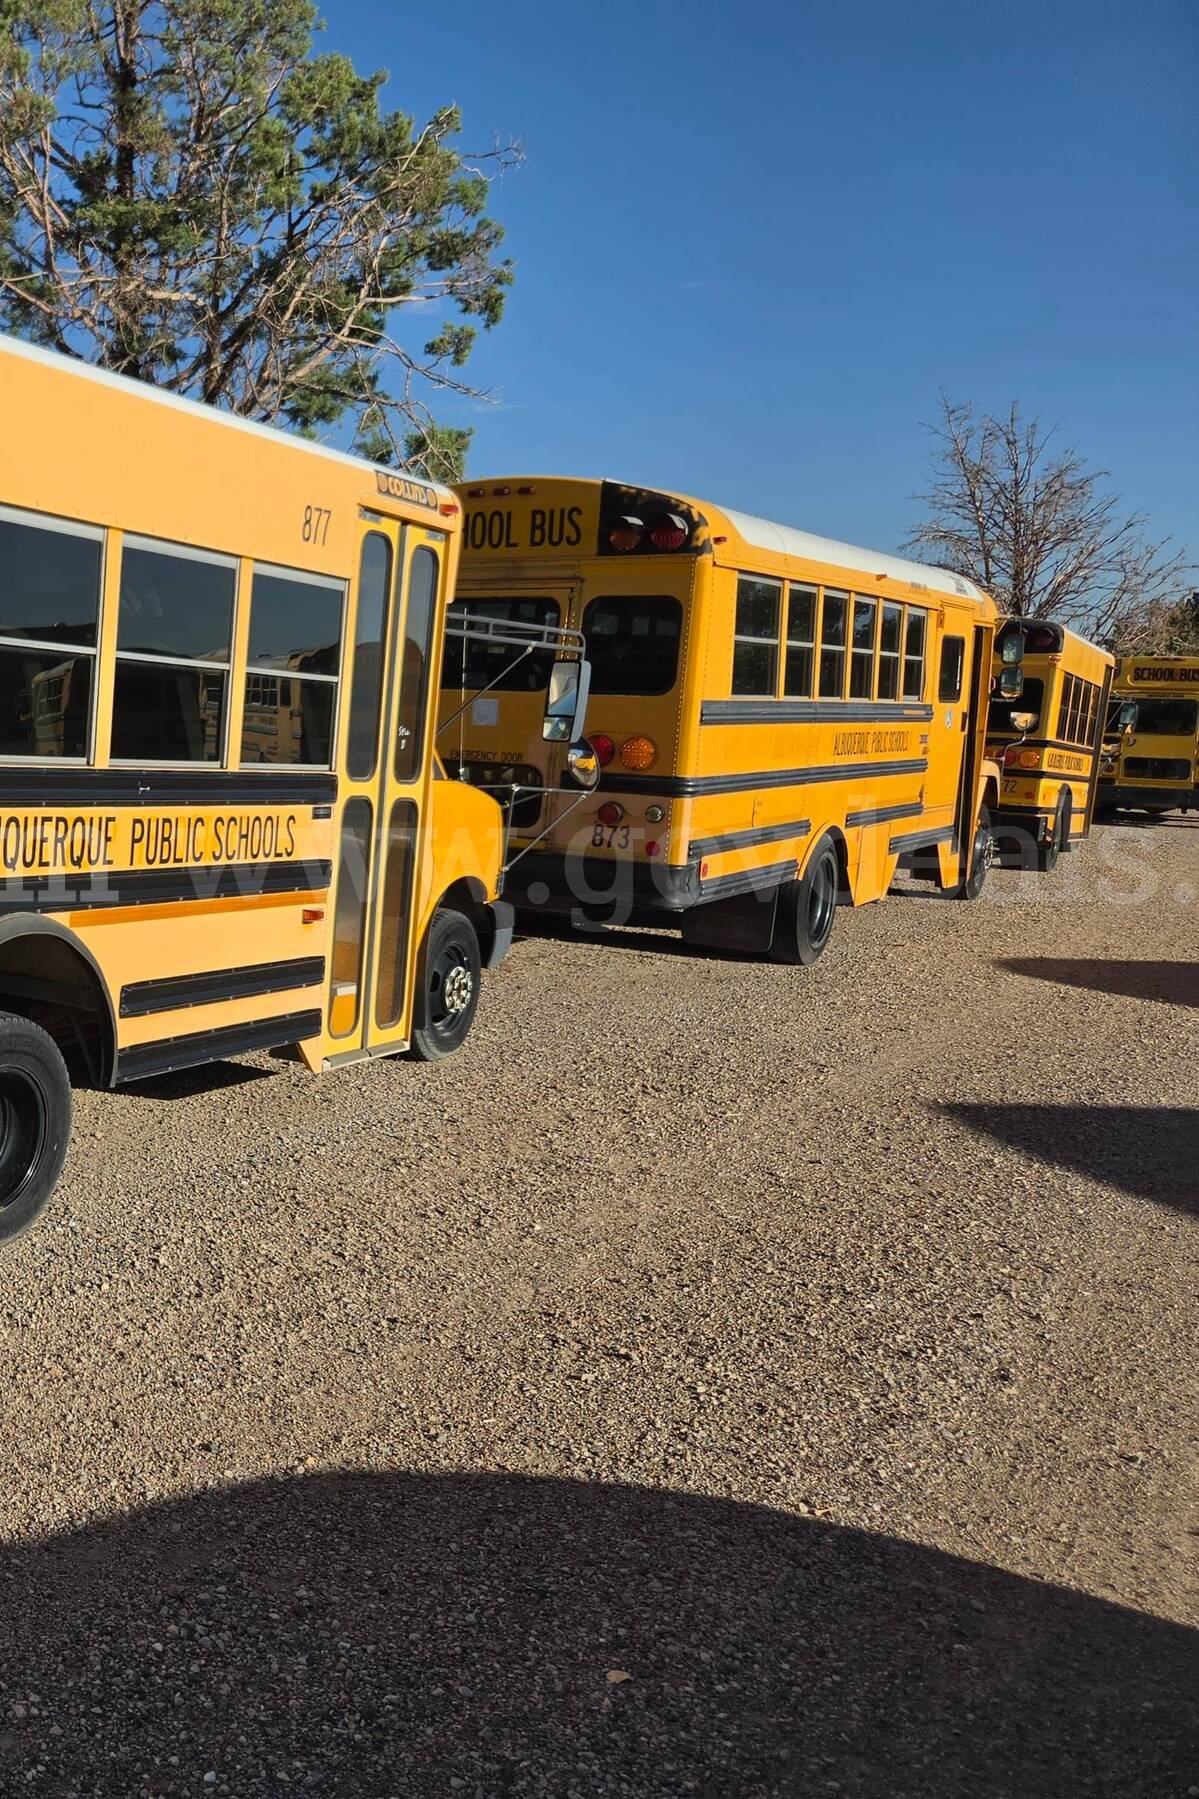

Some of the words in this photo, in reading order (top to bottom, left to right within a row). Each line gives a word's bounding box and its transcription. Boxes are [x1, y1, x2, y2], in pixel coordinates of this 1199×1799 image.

[387, 477, 428, 505] COLLINS
[302, 505, 332, 546] 877
[529, 506, 583, 548] BUS
[1133, 667, 1176, 681] SCHOOL
[450, 749, 497, 761] EMERGENCY
[501, 751, 524, 762] DOOR
[129, 816, 206, 866] PUBLIC
[212, 814, 296, 861] SCHOOLS
[591, 823, 630, 849] 873
